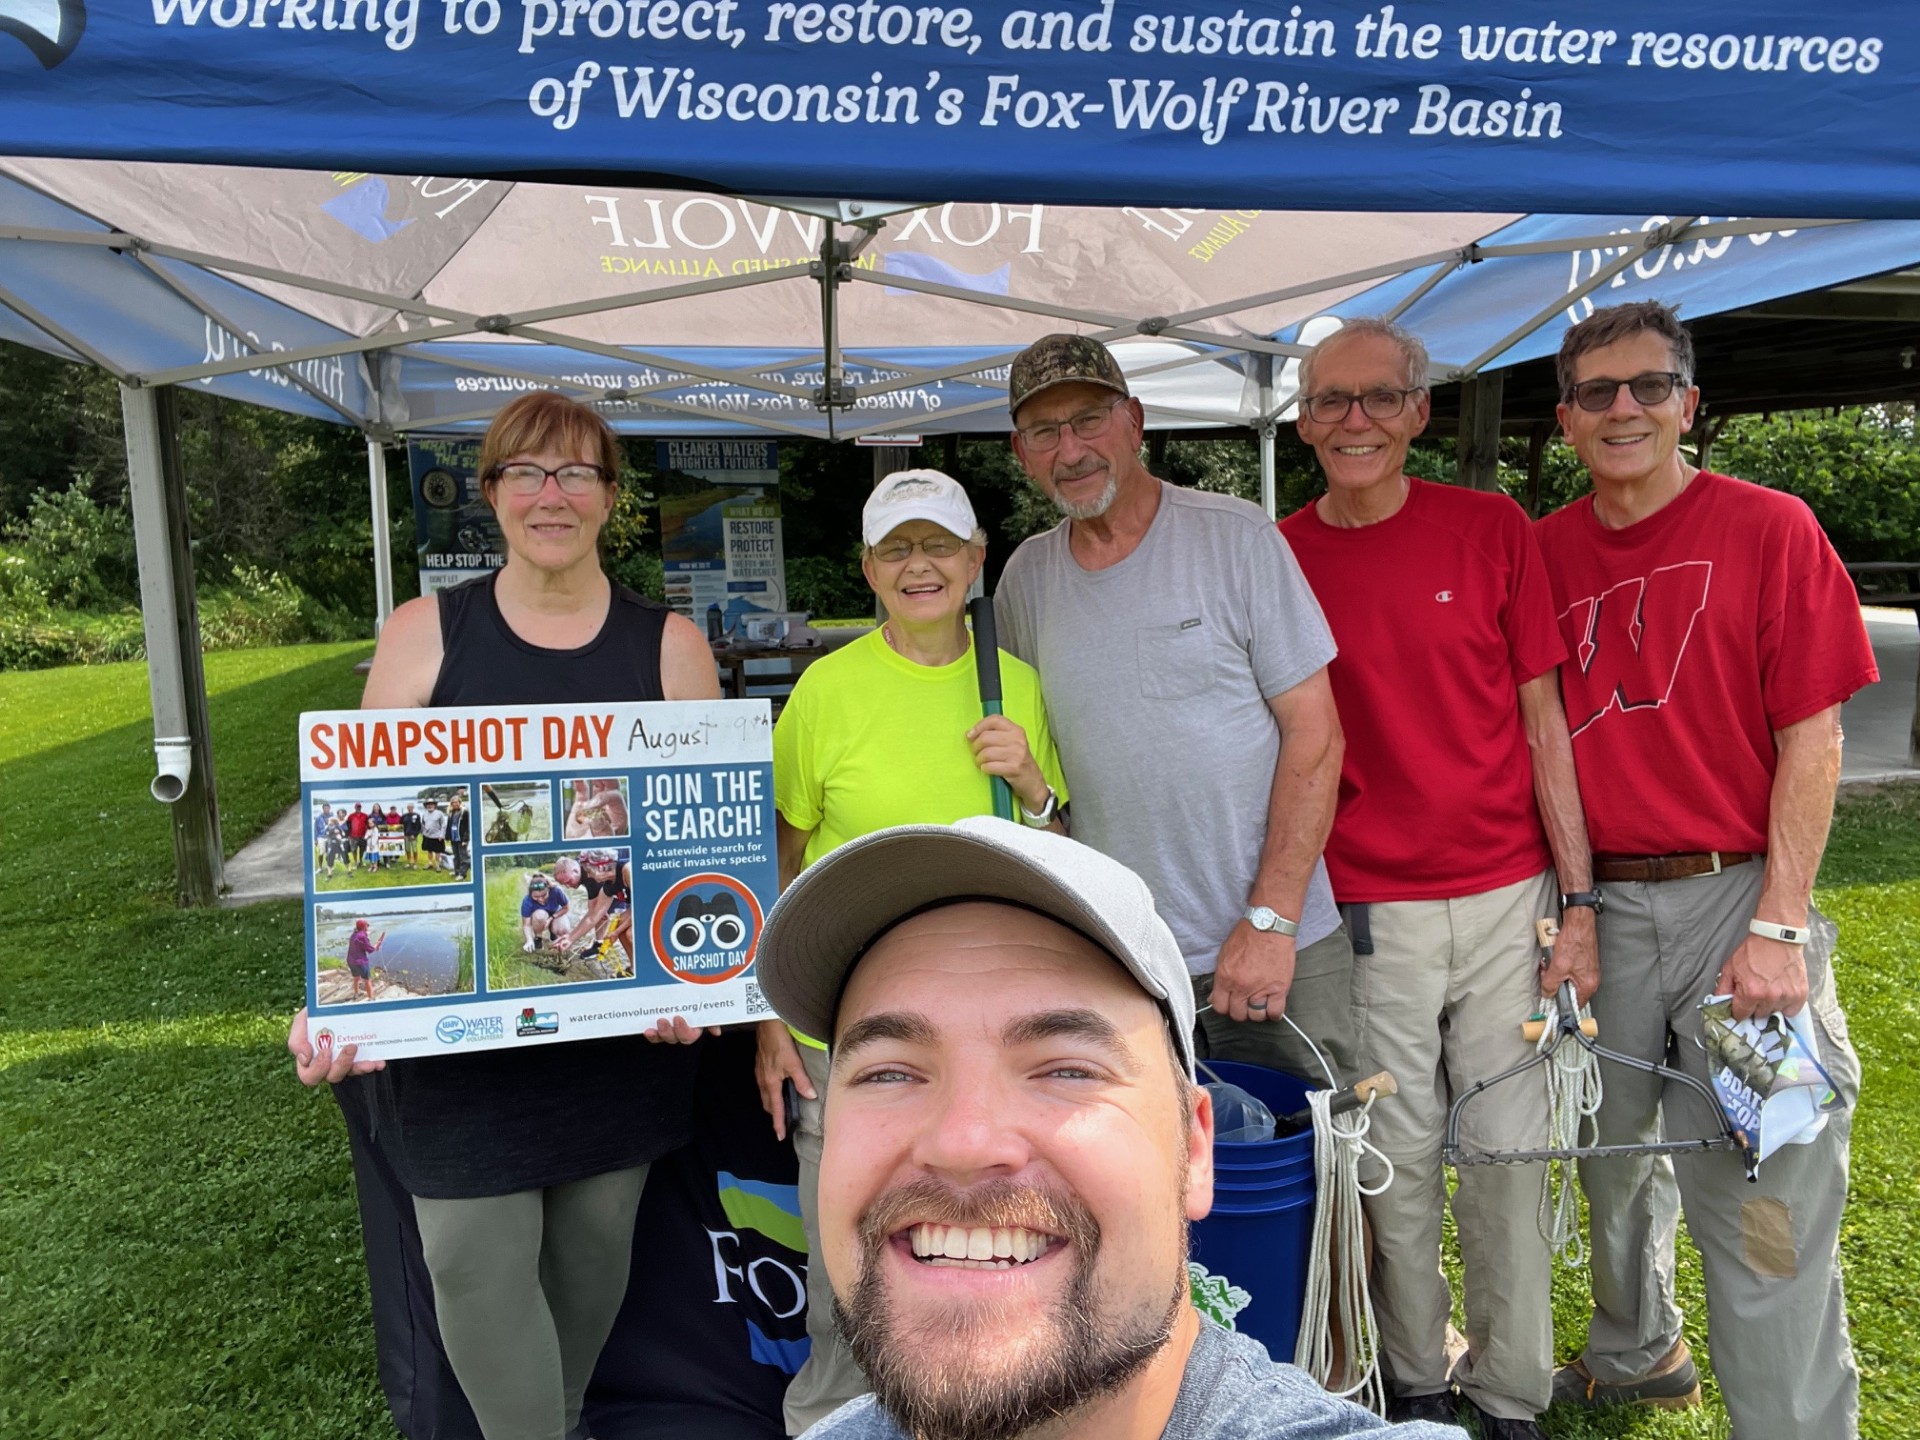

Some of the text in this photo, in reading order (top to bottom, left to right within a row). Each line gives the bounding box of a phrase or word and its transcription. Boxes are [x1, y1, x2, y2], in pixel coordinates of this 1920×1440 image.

[442, 0, 501, 34] to
[518, 0, 747, 53] protect,
[764, 0, 982, 55] restore,
[1001, 0, 1115, 52] and
[1129, 5, 1336, 57] sustain
[1355, 5, 1442, 59] the
[1458, 20, 1616, 64] water
[1627, 31, 1883, 74] resources
[528, 60, 1563, 145] of Wisconsin's Fox-Wolf River Basin
[668, 442, 769, 456] CLEANER WATERS
[669, 457, 768, 470] BRIGHTER FUTURES
[729, 506, 750, 516] WHAT
[729, 521, 775, 535] RESTORE
[730, 539, 775, 553] PROTECT
[426, 553, 505, 568] HELP STOP THE
[310, 715, 615, 770] SNAPSHOT DAY
[628, 714, 718, 758] August
[642, 770, 764, 807] JOIN THE
[645, 805, 762, 842] SEARCH!
[646, 842, 763, 858] A statewide search for
[642, 853, 767, 871] aquatic invasive species
[672, 950, 747, 971] SNAPSHOT DAY
[569, 998, 735, 1023] wateractionvolunteers.org/events
[466, 1016, 503, 1028] WATER
[337, 1032, 377, 1043] Extension
[465, 1034, 504, 1042] VOLUNTEERS
[467, 1025, 503, 1037] ACTION
